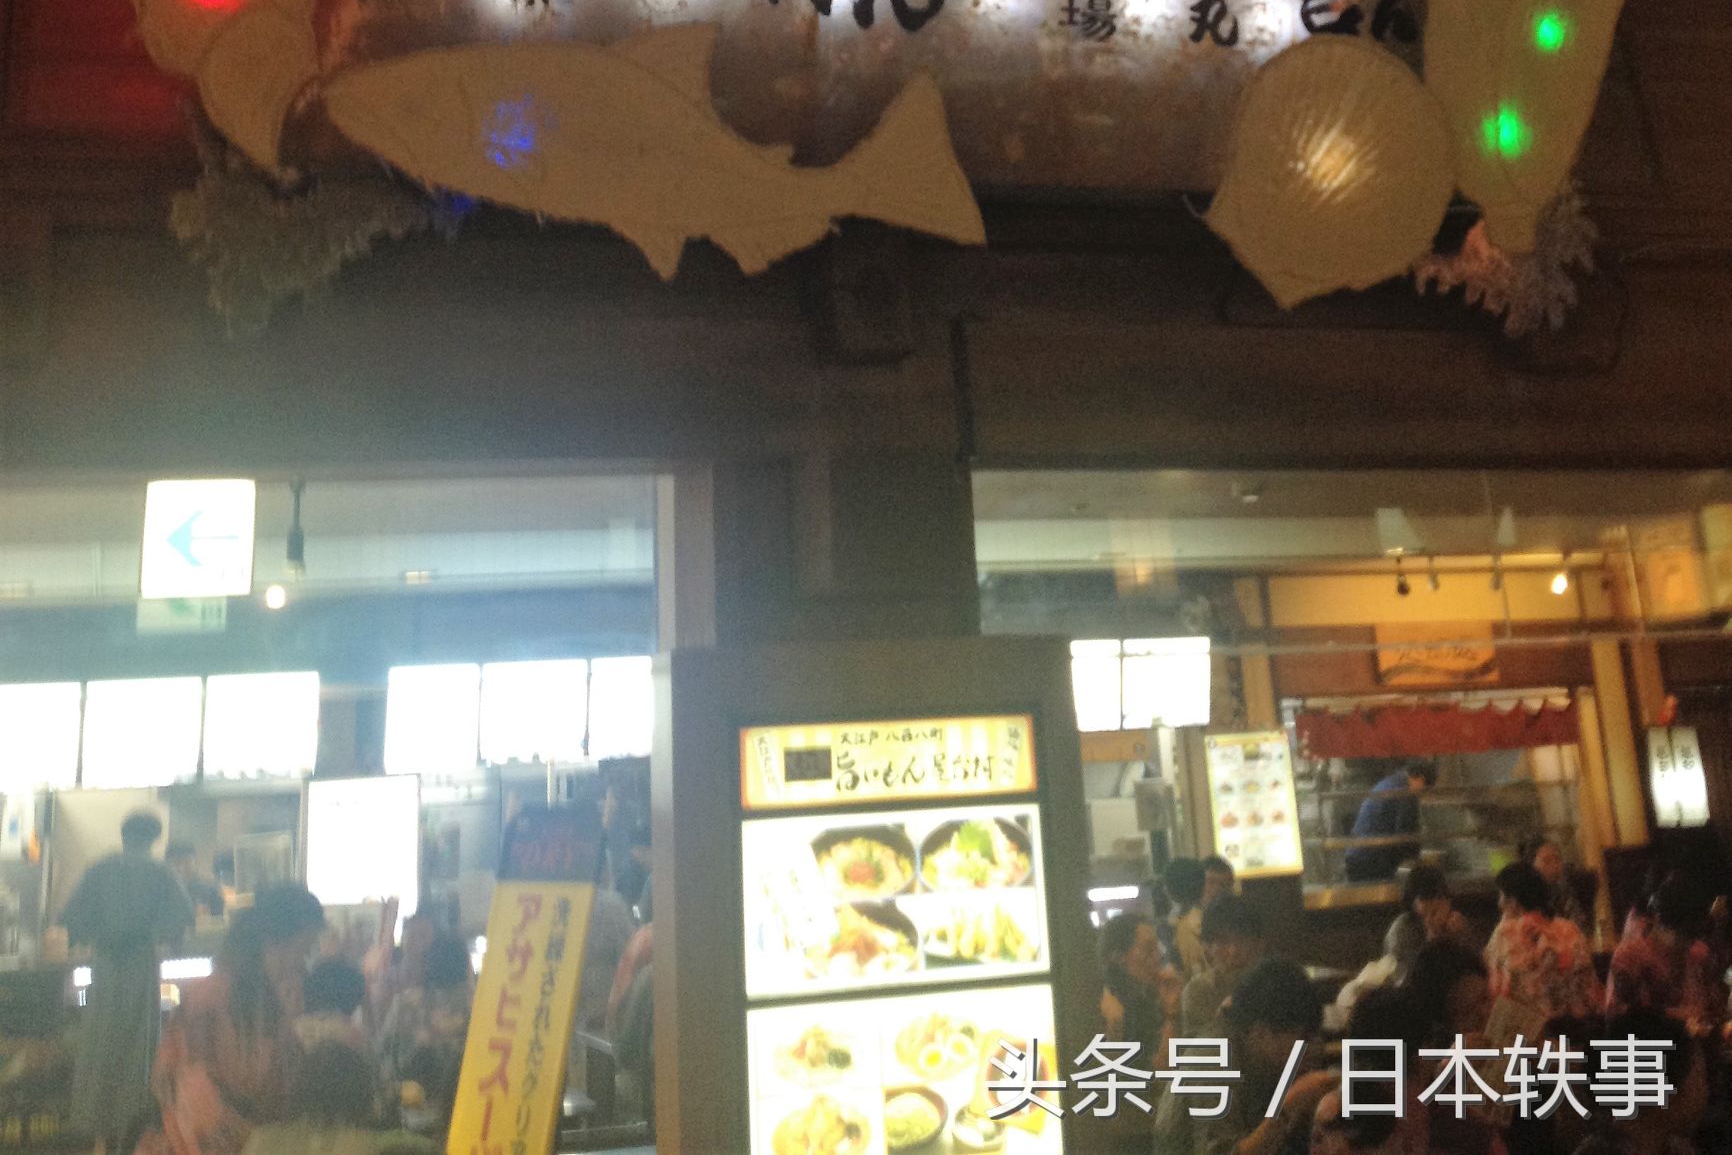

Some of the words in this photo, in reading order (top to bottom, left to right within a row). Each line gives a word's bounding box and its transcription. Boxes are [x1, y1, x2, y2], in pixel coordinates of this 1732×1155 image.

[470, 893, 544, 1155] アサヒスー
